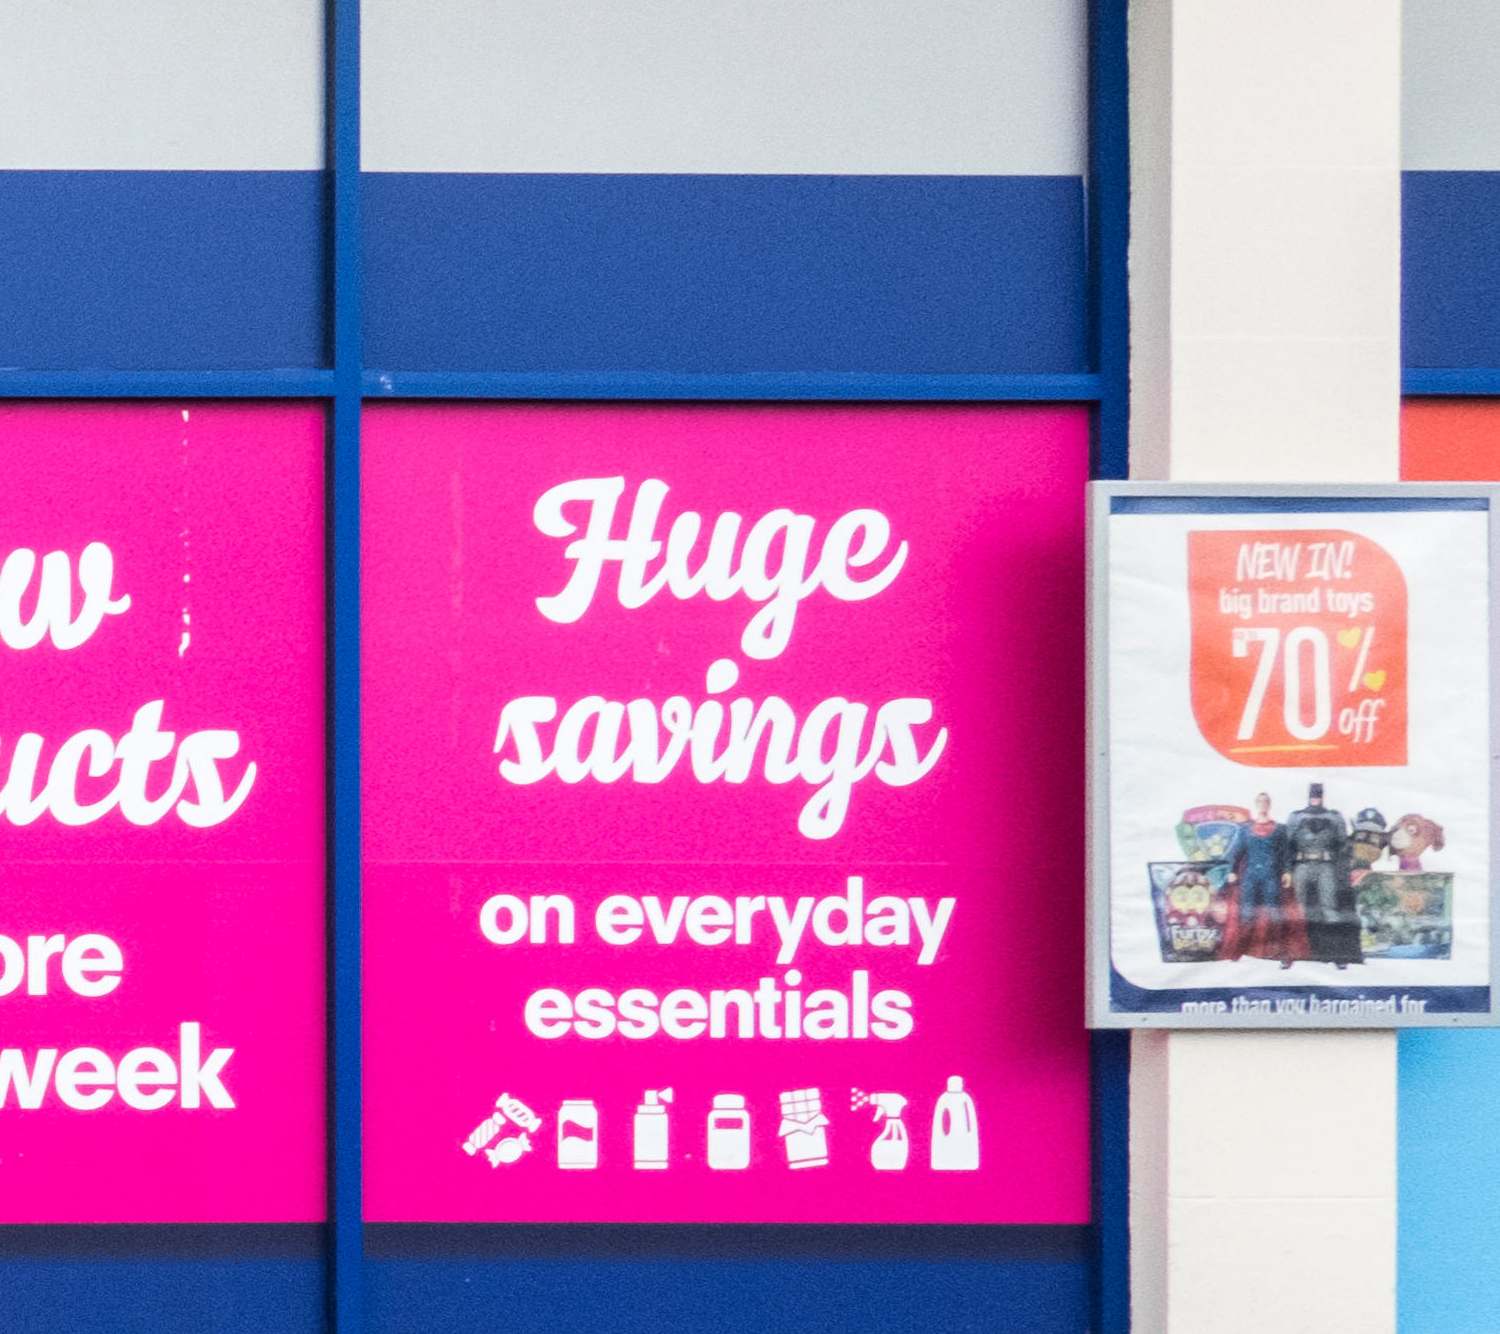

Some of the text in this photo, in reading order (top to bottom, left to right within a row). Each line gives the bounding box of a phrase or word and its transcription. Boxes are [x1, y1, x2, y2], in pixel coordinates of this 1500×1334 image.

[533, 476, 909, 660] Huge
[1236, 540, 1355, 581] NEW IN!
[1219, 588, 1374, 620] big brand toys
[494, 658, 948, 840] savings
[1338, 698, 1386, 744] off
[479, 876, 956, 965] on everyday
[524, 970, 913, 1040] essentials
[1181, 994, 1428, 1013] more than you bargained for
